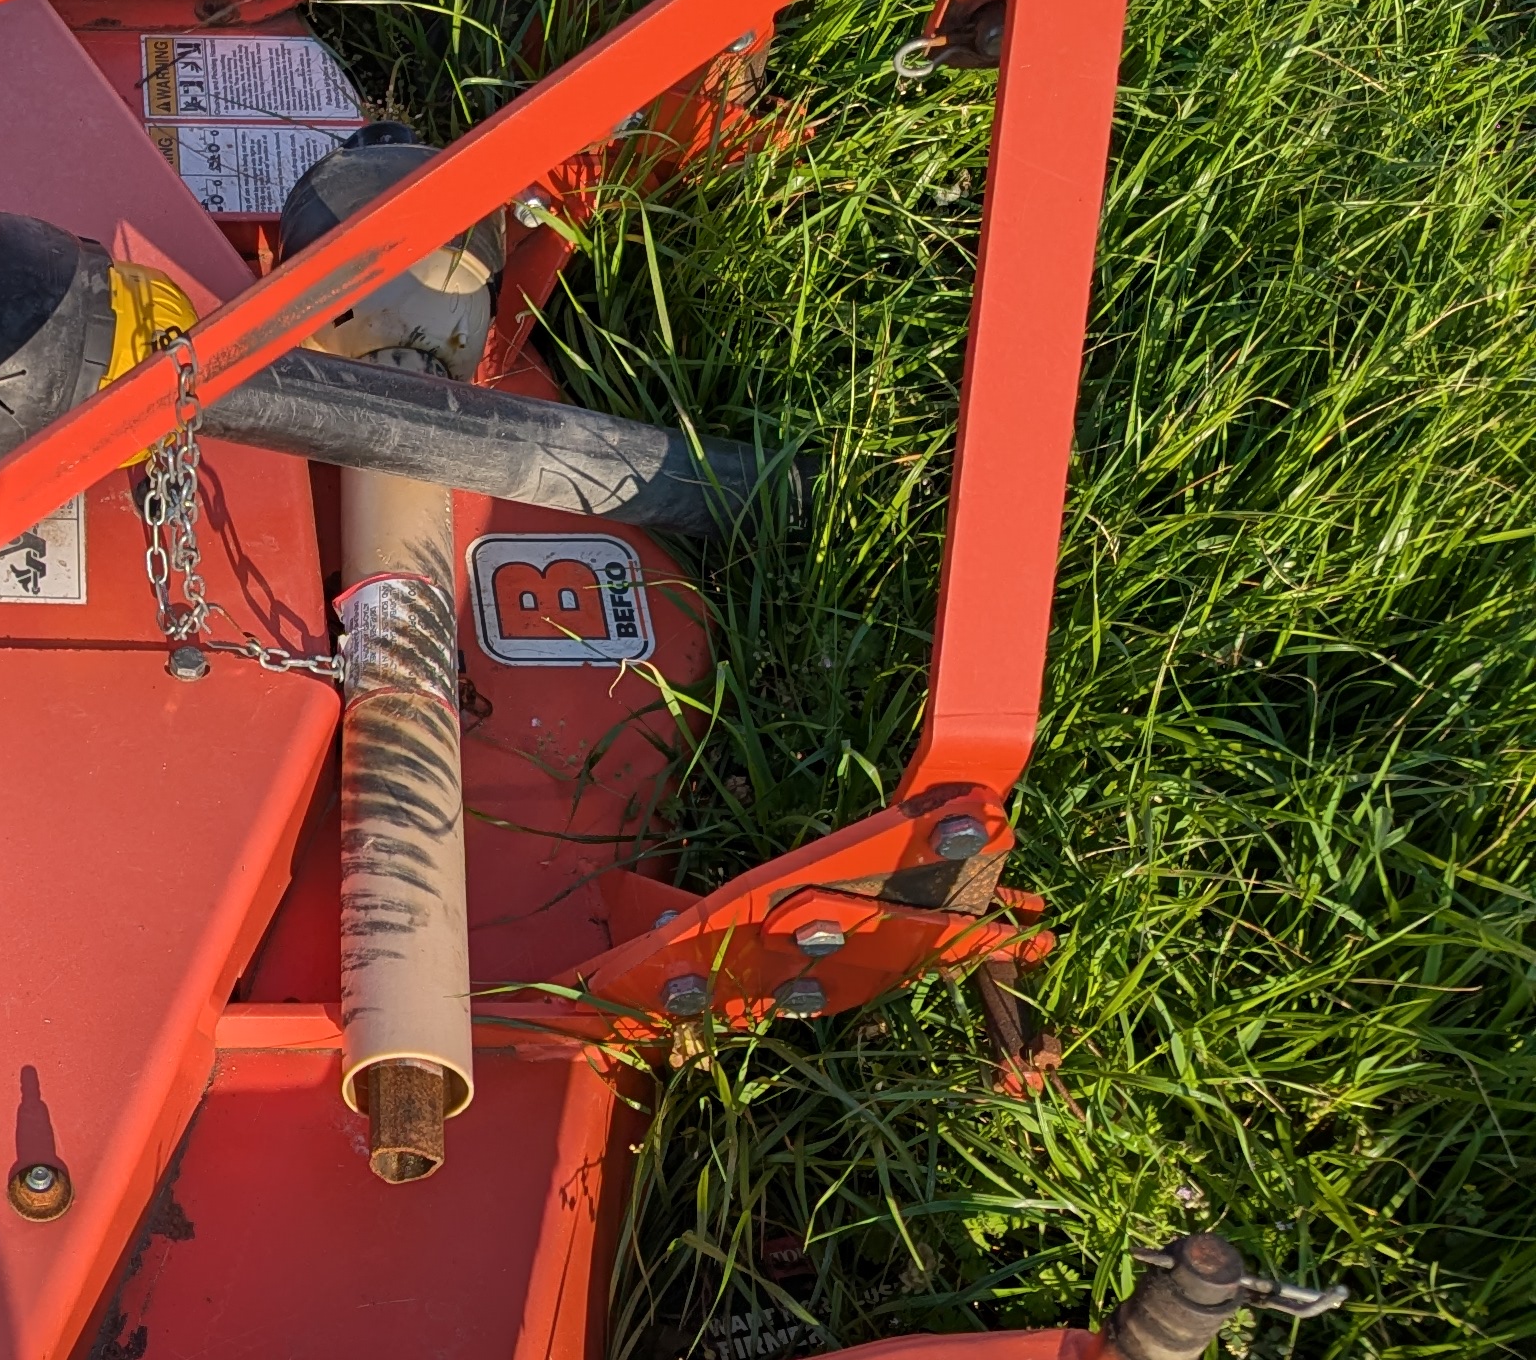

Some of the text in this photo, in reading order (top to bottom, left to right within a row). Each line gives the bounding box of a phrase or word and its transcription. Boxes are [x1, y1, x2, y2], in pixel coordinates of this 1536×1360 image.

[154, 41, 171, 100] WARNING
[492, 559, 611, 640] B
[605, 561, 639, 638] BEFCO
